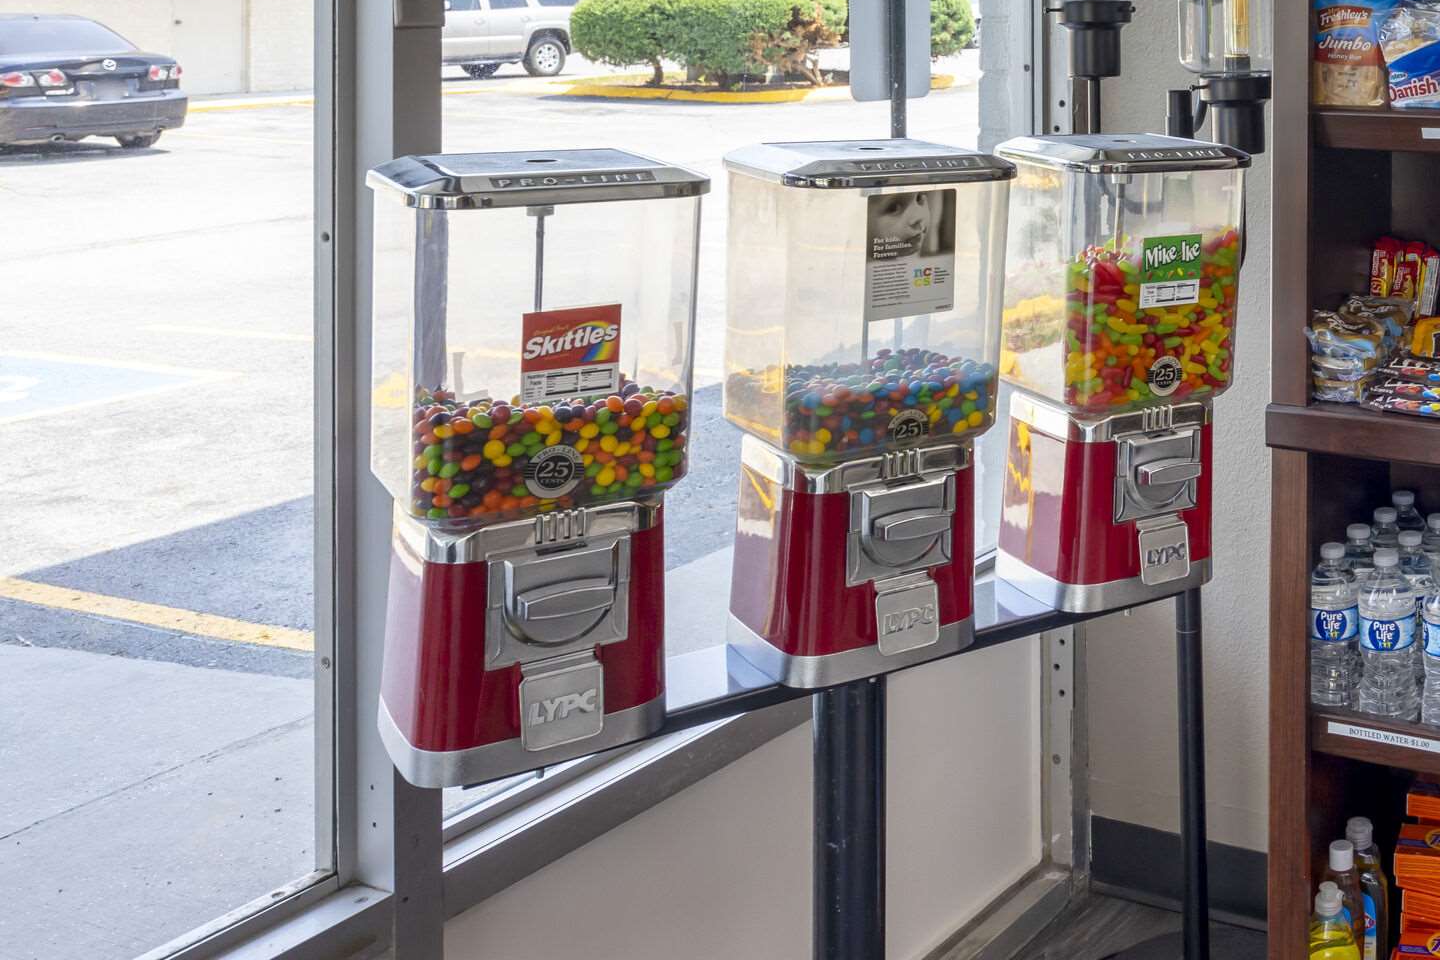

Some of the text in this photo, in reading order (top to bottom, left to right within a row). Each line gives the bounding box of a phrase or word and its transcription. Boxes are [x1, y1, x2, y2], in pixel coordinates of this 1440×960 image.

[1319, 35, 1372, 51] Jumbo
[1327, 52, 1361, 62] Honey Bun
[1389, 77, 1438, 101] Danish
[1146, 240, 1200, 271] Mike Ike
[524, 324, 618, 360] Skittles
[1156, 368, 1174, 381] 25
[896, 422, 919, 439] 25
[538, 461, 570, 478] 25
[1145, 540, 1185, 568] LYPC
[882, 603, 933, 635] LYPC
[1321, 611, 1343, 621] Pure
[1323, 619, 1340, 631] Life
[1373, 621, 1395, 631] Pure
[1376, 630, 1393, 642] Life
[528, 688, 597, 728] LYPC
[1349, 727, 1381, 740] BOTTLED
